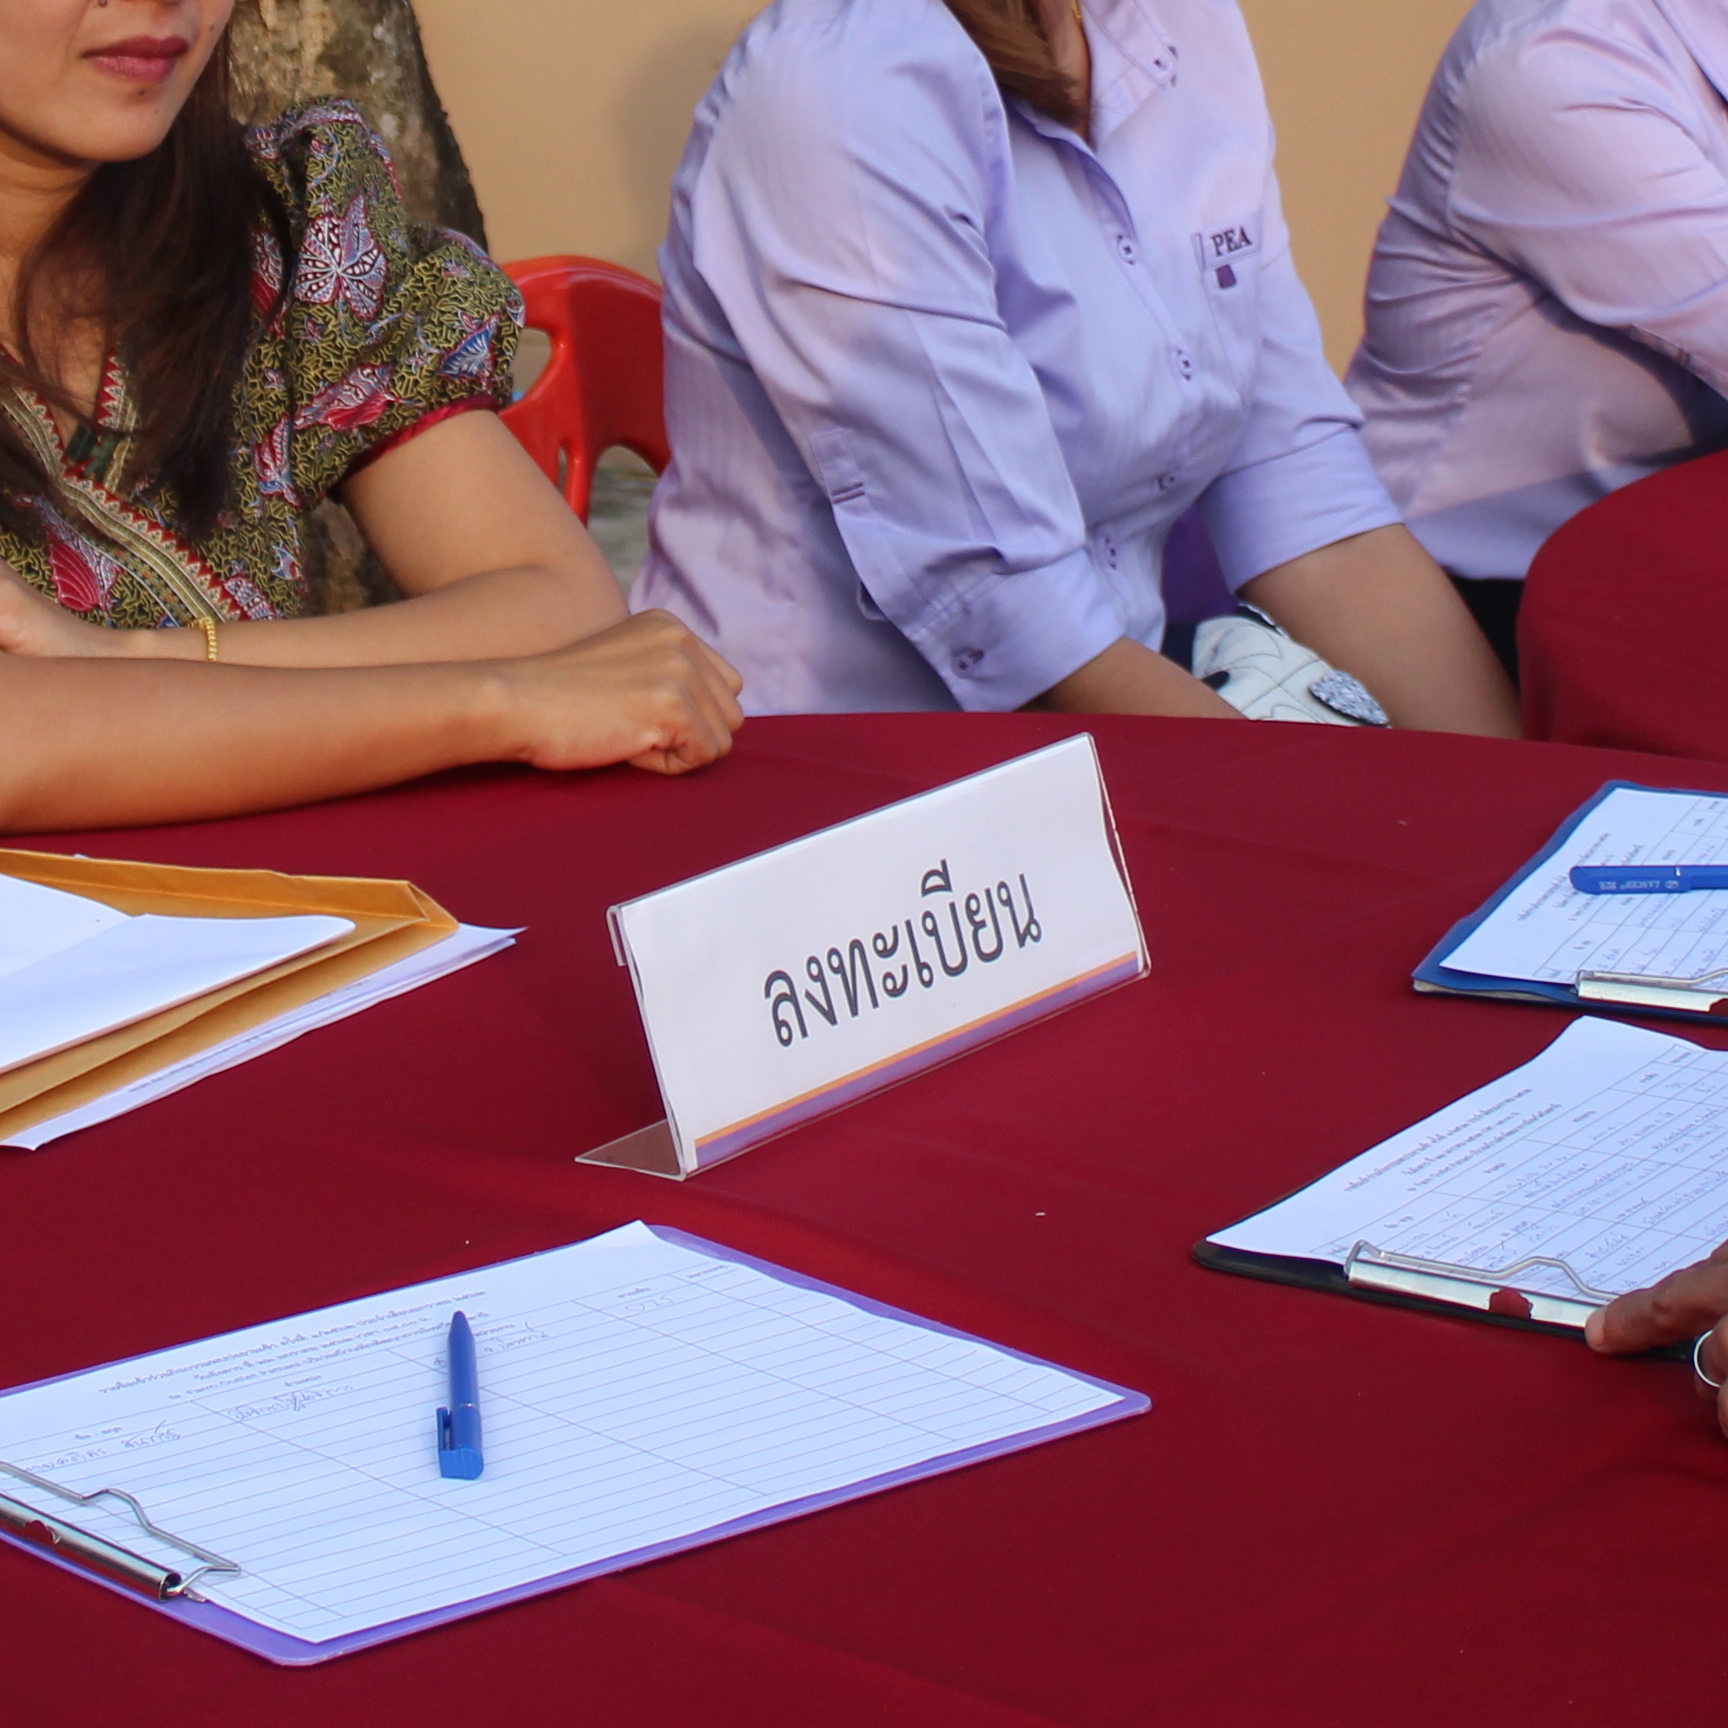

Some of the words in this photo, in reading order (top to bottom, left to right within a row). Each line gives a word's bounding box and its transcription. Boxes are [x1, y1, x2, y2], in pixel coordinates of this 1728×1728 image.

[1211, 226, 1252, 257] PEA
[762, 859, 1043, 1048] ลงทะเบียน
